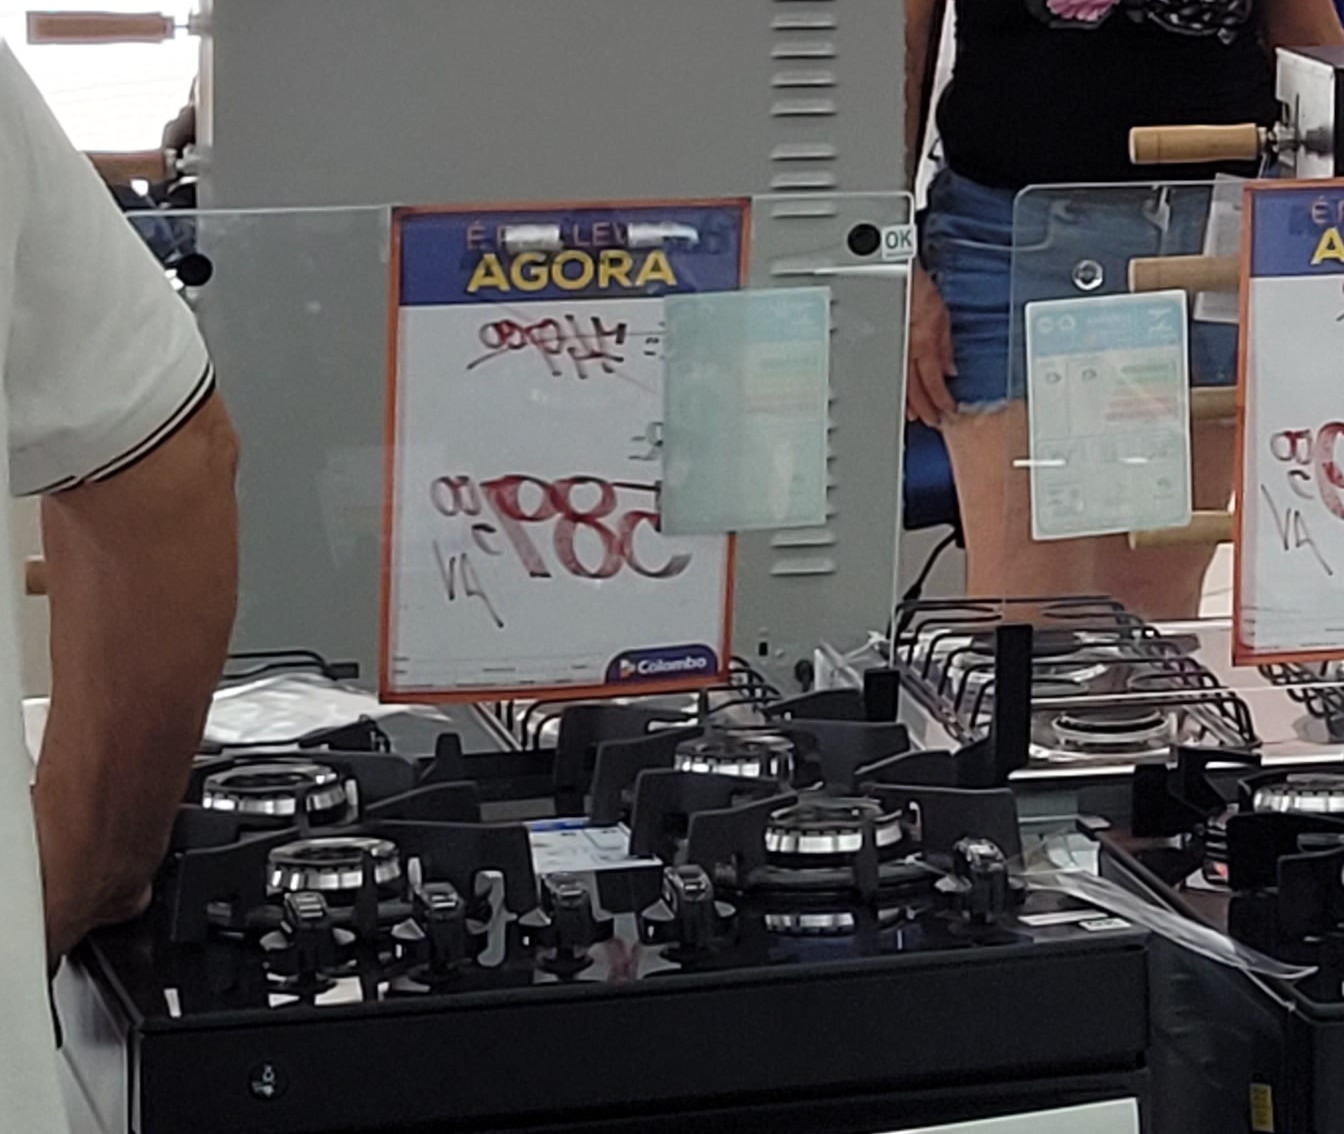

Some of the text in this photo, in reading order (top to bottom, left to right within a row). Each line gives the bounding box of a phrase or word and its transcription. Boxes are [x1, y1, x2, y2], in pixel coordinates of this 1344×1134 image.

[1312, 195, 1329, 224] É
[885, 228, 912, 250] OK
[467, 250, 678, 293] AGORA
[637, 655, 707, 675] Colombo
